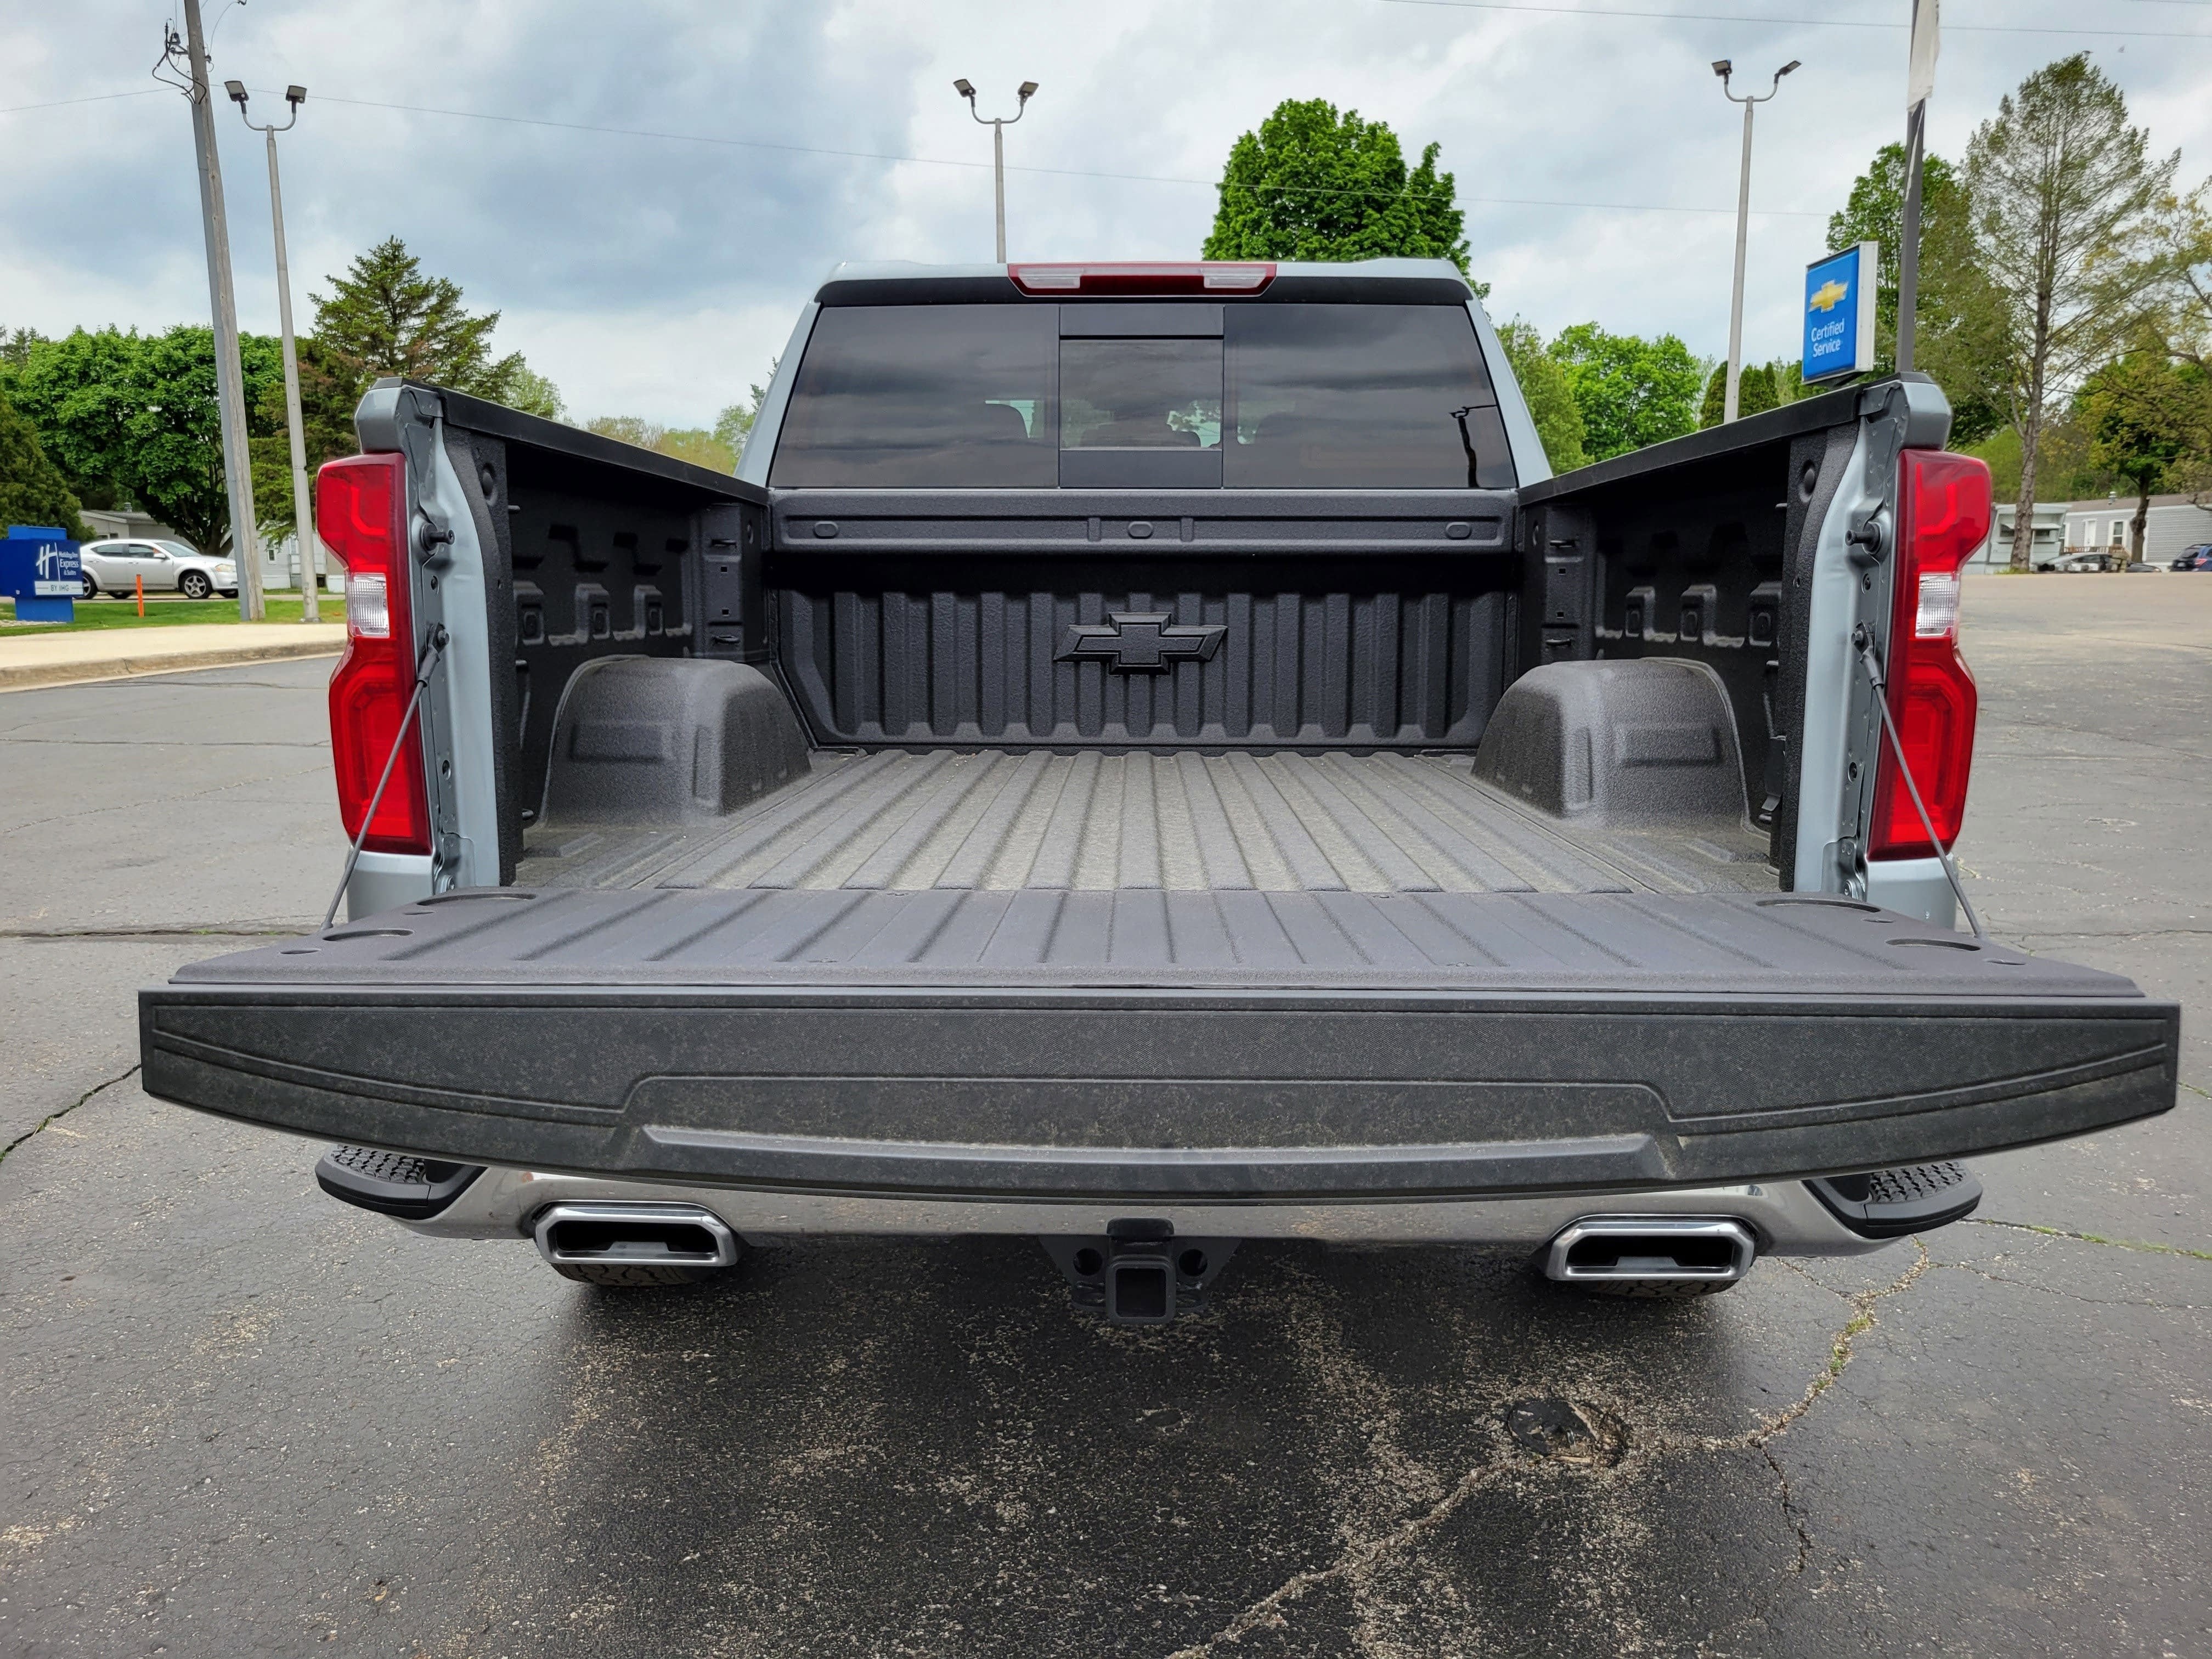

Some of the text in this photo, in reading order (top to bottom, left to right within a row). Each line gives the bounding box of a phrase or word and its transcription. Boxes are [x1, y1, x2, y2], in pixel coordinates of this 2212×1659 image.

[1812, 318, 1844, 342] Certified
[1813, 338, 1841, 358] Service
[60, 558, 79, 568] Express
